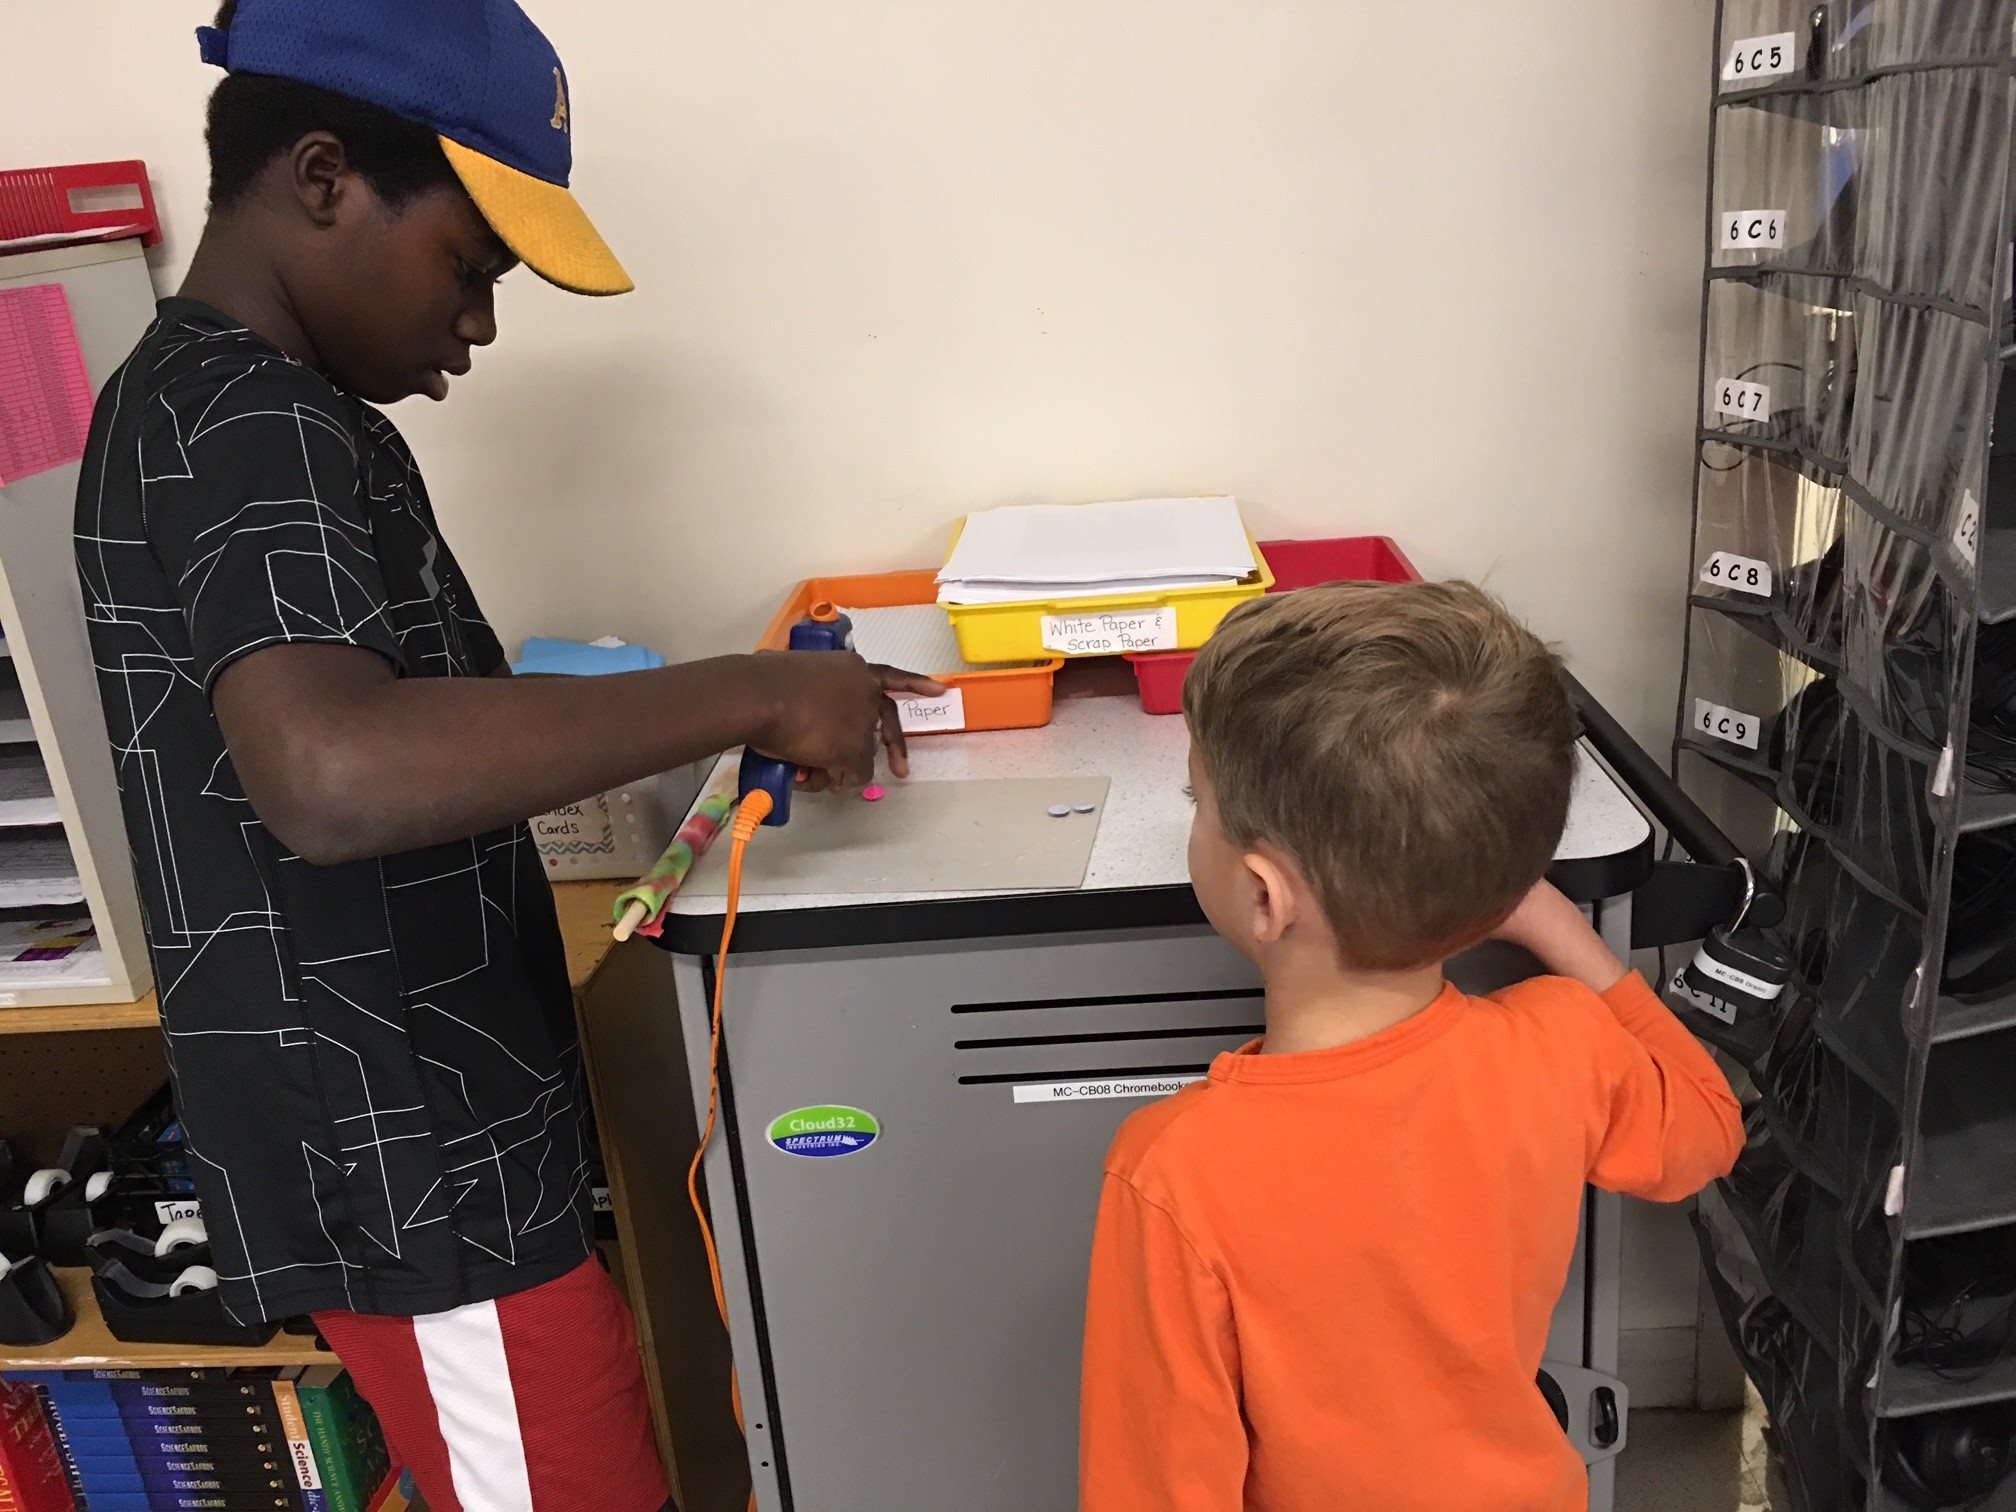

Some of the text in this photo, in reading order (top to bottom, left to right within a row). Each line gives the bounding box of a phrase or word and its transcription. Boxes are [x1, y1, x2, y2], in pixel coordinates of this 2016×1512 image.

[1050, 620, 1096, 636] White
[1099, 615, 1146, 634] Paper
[1118, 633, 1158, 648] Paper
[903, 699, 950, 720] Paper
[537, 820, 579, 835] Cards
[1053, 1085, 1111, 1097] MC-CB08
[789, 1116, 856, 1132] Cloud32
[785, 1135, 842, 1146] SPECTRUM
[280, 1395, 299, 1439] Student
[293, 1443, 312, 1487] Science
